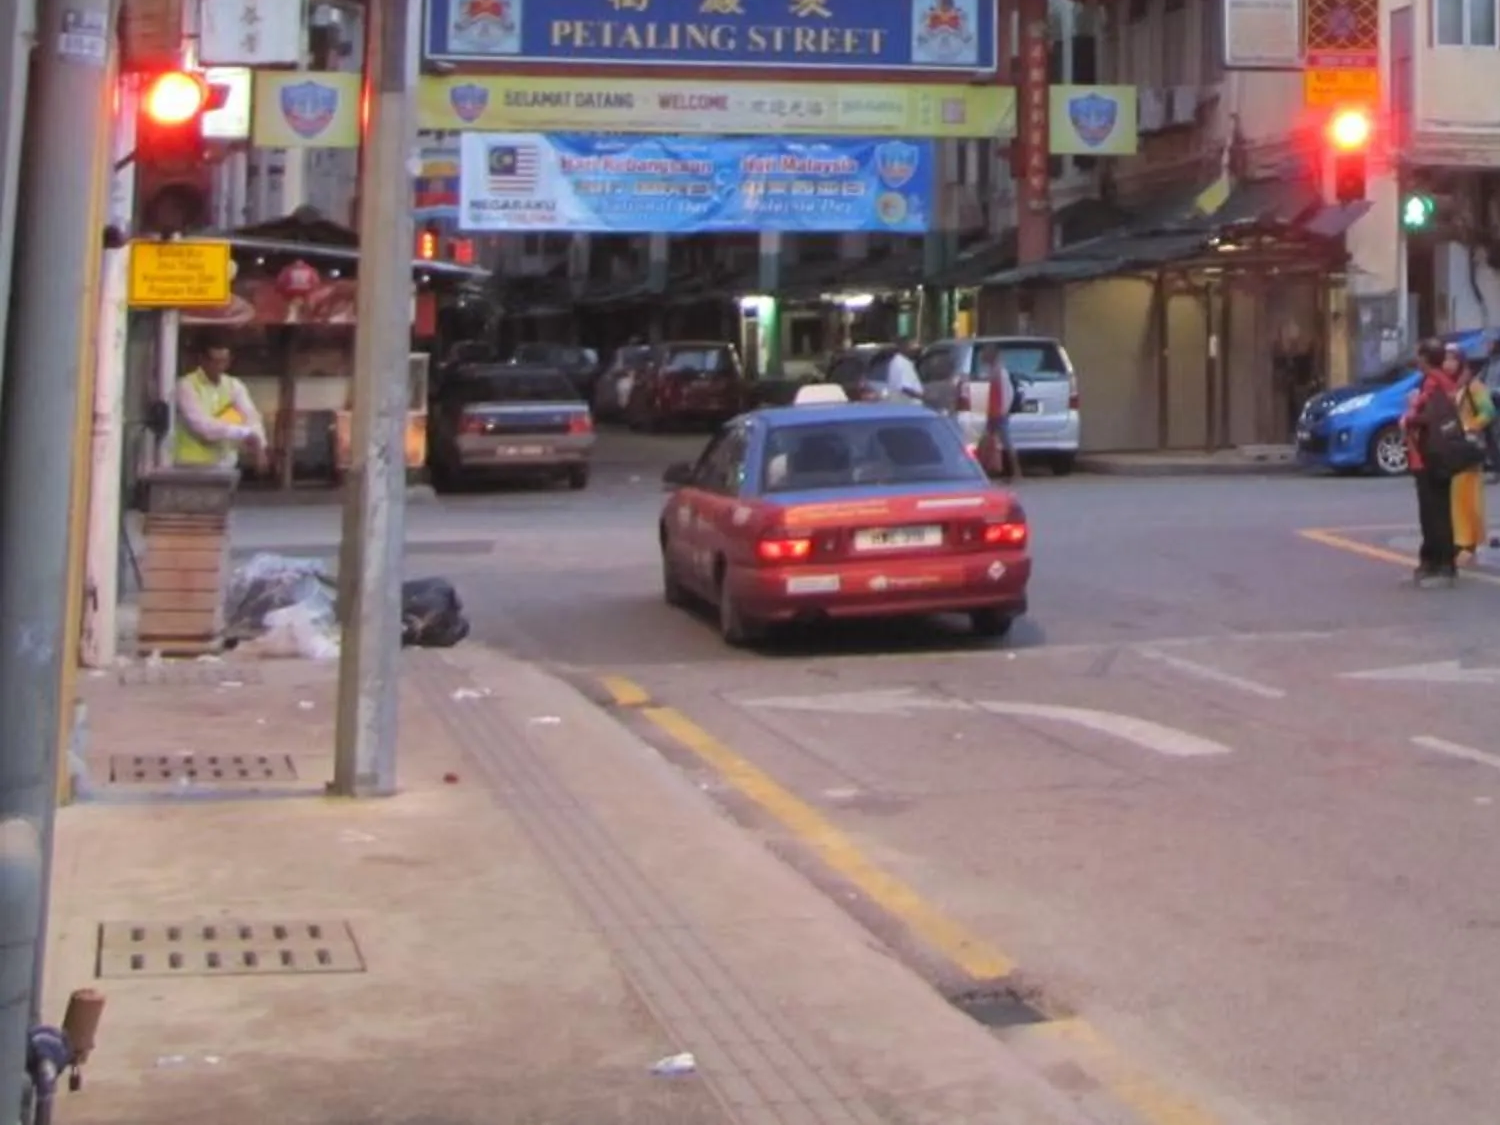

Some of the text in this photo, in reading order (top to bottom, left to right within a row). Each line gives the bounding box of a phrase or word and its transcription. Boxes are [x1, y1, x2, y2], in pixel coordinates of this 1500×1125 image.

[550, 19, 889, 56] PETALING STREET
[503, 90, 572, 108] SELAMAT
[658, 92, 729, 111] WELCOME
